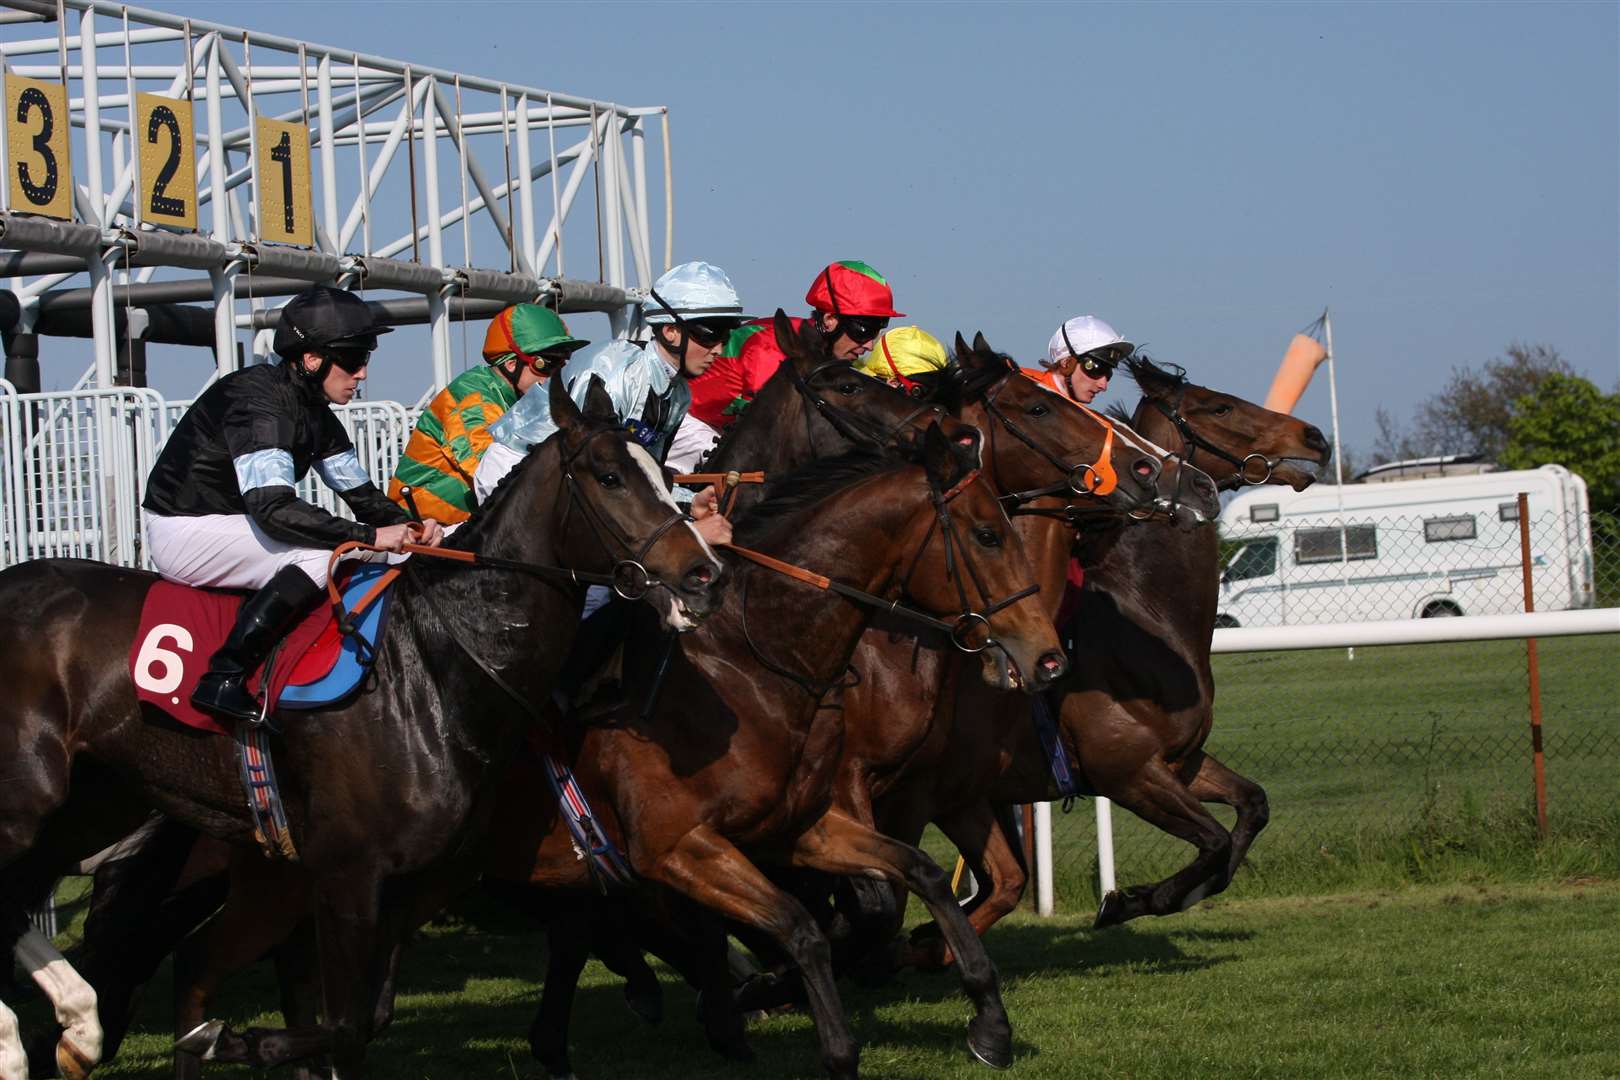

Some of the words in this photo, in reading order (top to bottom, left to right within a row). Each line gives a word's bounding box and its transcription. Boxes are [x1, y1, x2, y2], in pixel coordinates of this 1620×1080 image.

[17, 87, 58, 206] 3
[148, 105, 185, 217] 2
[270, 131, 294, 234] 1
